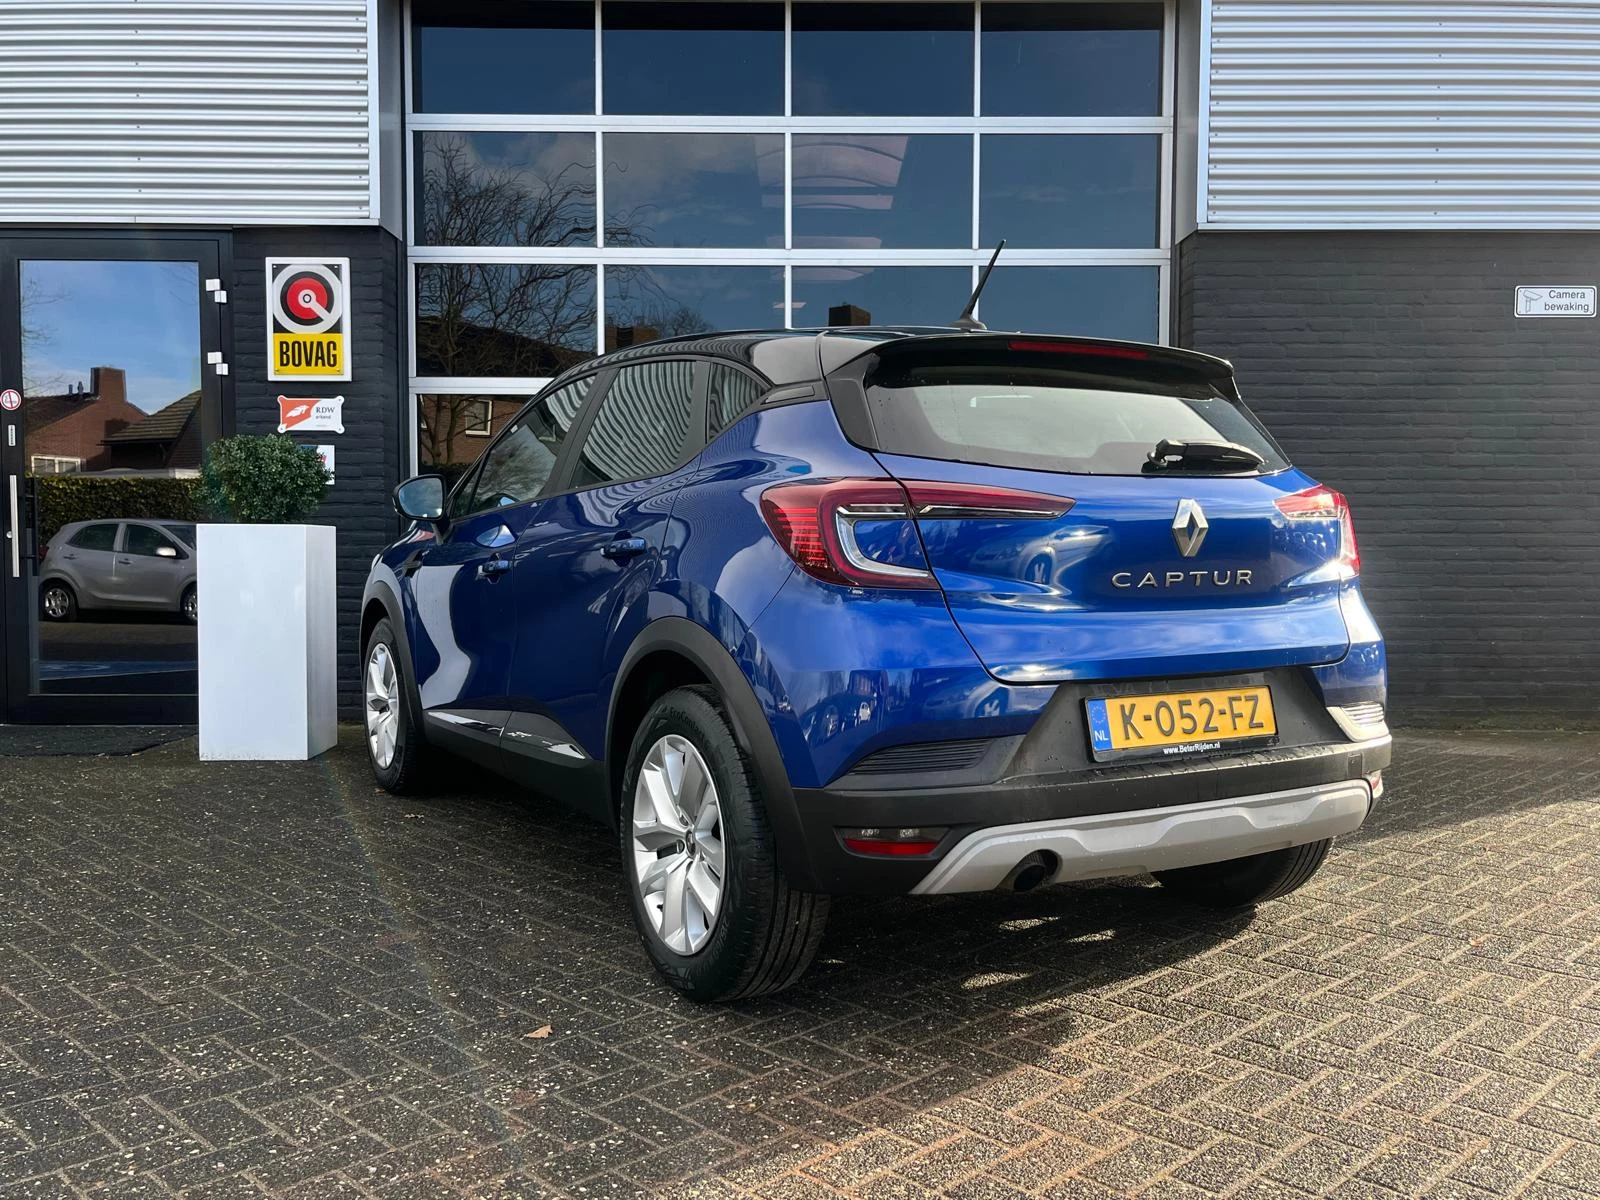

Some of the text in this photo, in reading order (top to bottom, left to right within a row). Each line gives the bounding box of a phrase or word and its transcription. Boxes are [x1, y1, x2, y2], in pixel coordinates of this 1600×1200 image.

[1548, 289, 1586, 299] Camera
[1544, 302, 1590, 313] bewaking
[279, 340, 337, 368] BOVAG
[1111, 569, 1253, 588] CAPTUR
[1119, 693, 1264, 741] K-052-FZ
[1094, 730, 1109, 742] NL
[1162, 741, 1221, 755] www.BeterRijden.nl
